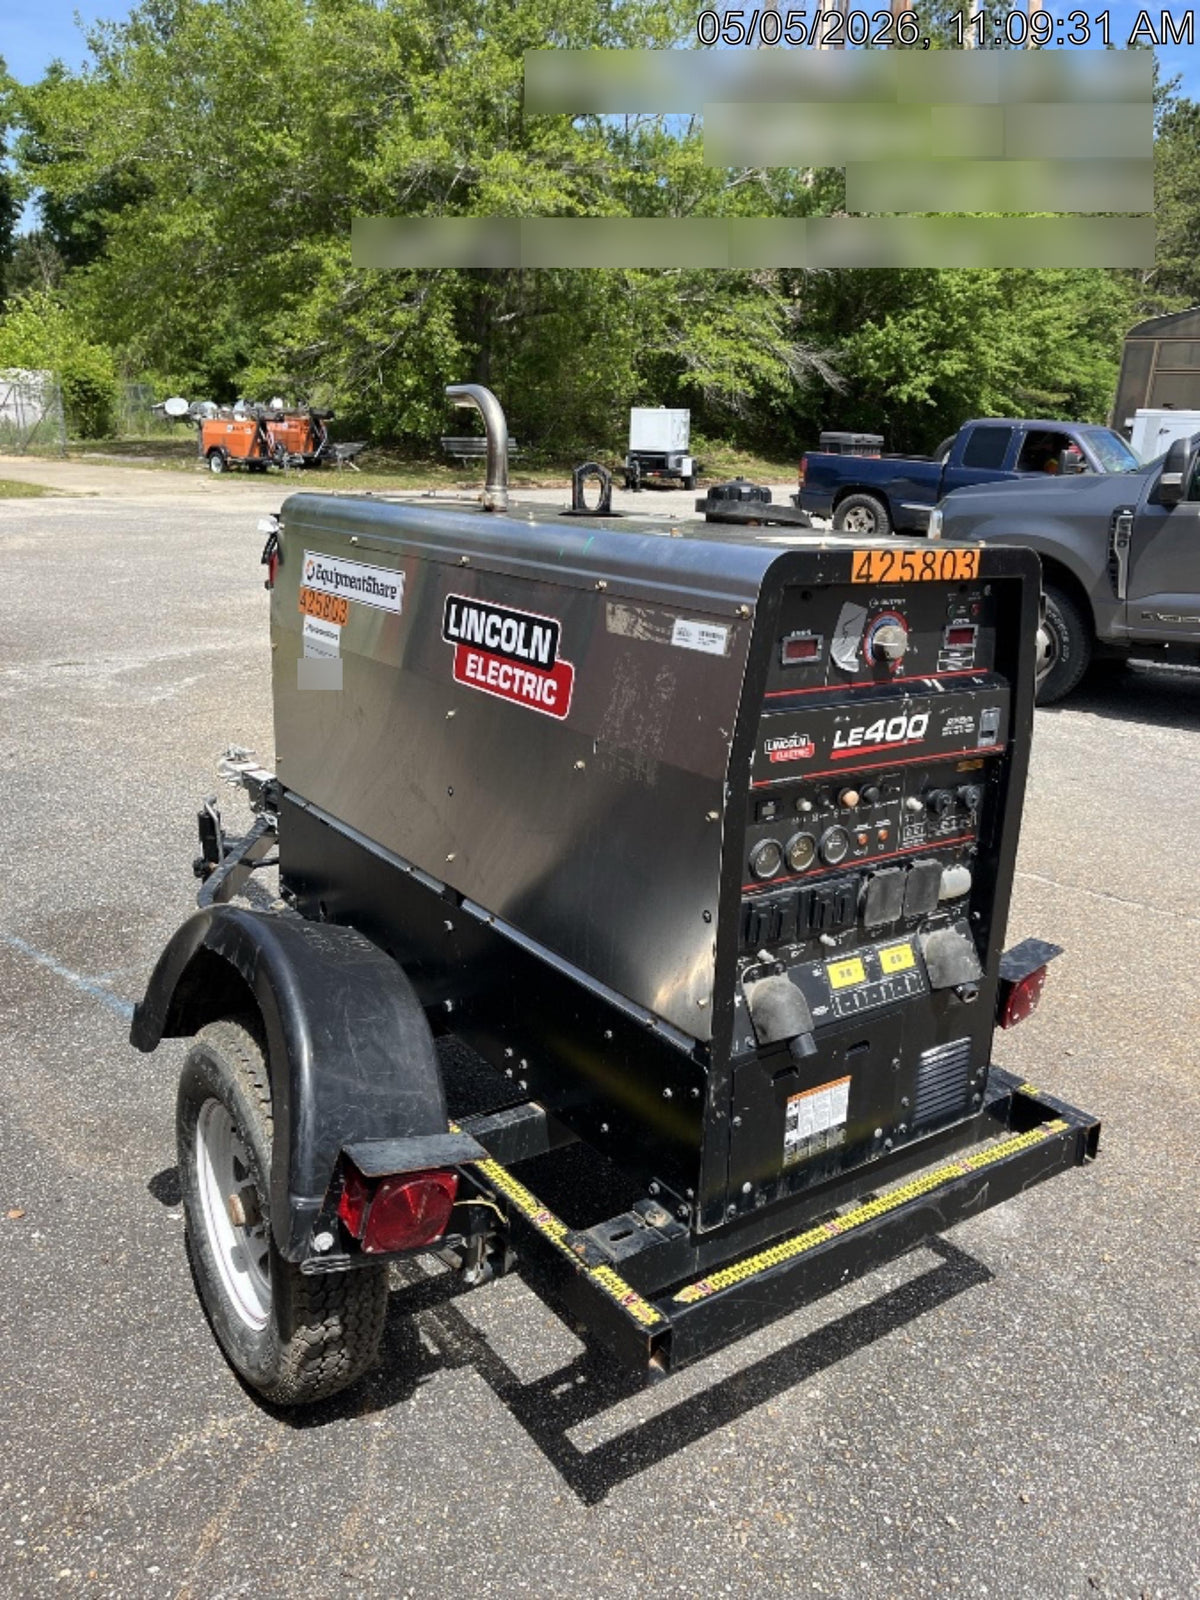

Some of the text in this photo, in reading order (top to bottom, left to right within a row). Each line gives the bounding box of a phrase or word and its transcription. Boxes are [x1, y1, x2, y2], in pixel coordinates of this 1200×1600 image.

[315, 562, 398, 600] EquipmentShare
[855, 550, 975, 583] 425803
[299, 590, 347, 623] 425803
[448, 603, 552, 664] LINCOLN
[465, 653, 558, 706] ELECTRIC
[767, 737, 807, 750] LINCOLN
[832, 713, 929, 749] LE400
